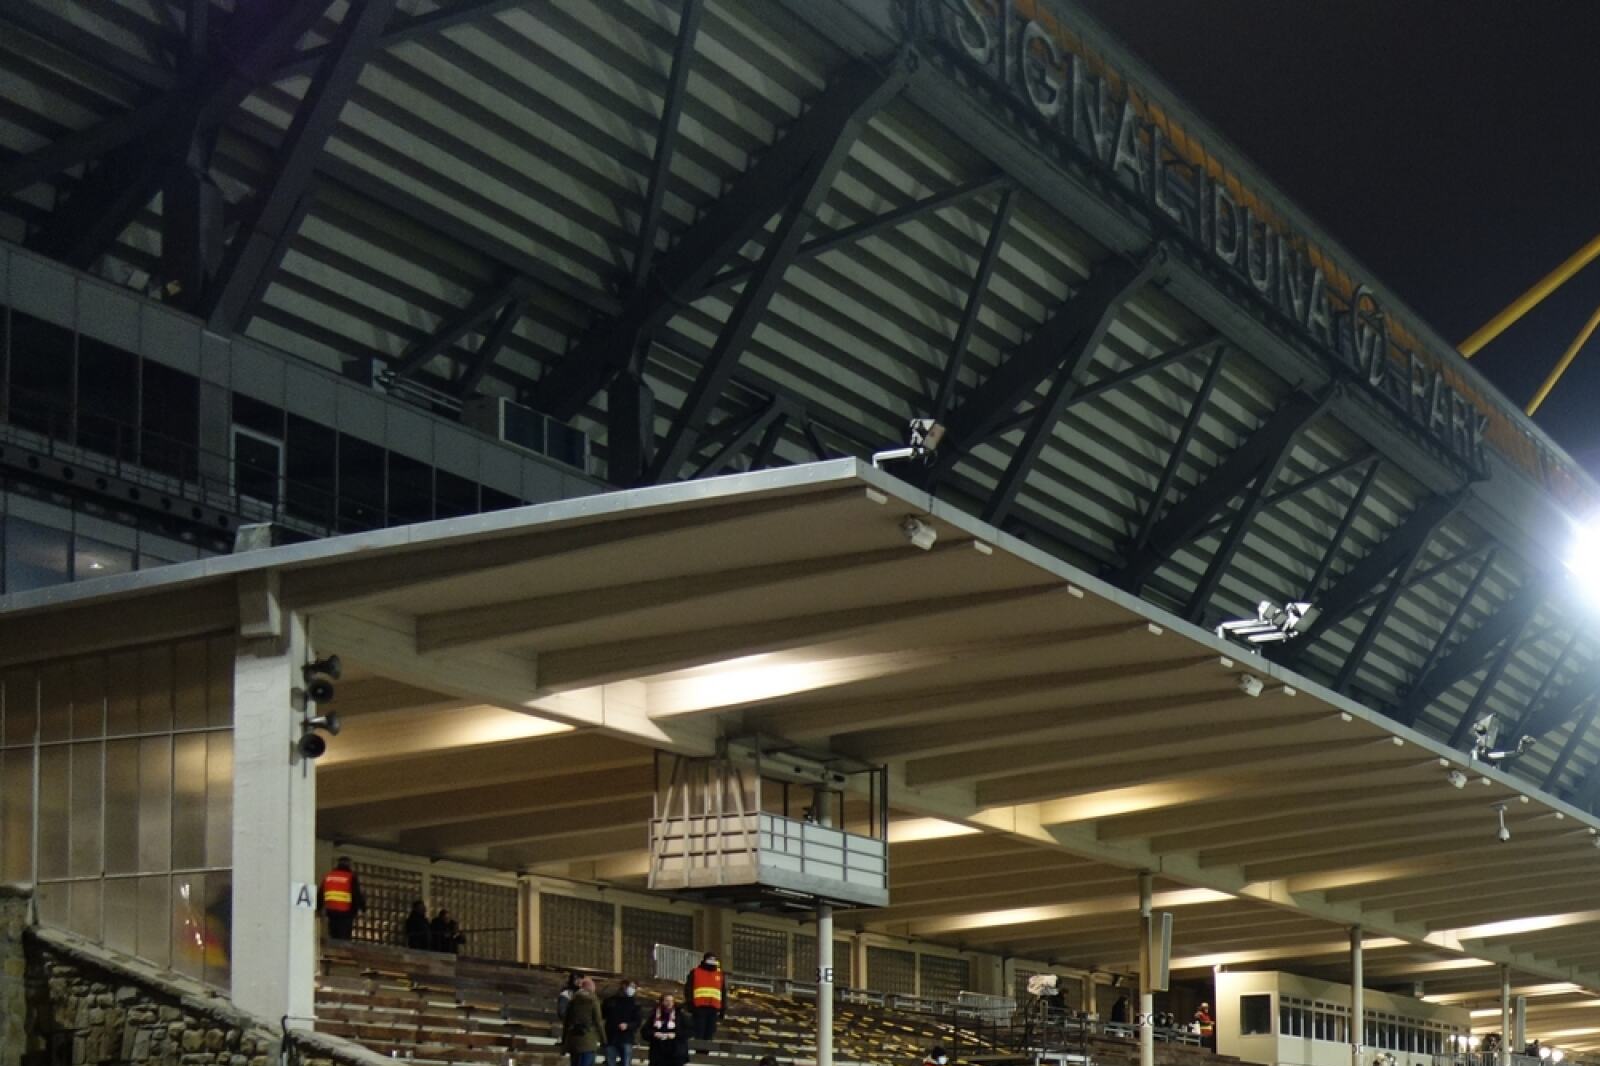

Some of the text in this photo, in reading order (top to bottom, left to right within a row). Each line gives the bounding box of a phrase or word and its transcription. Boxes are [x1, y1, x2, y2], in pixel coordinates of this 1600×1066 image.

[948, 0, 1489, 470] SIGNAL IDUNA PARK
[296, 885, 311, 907] A
